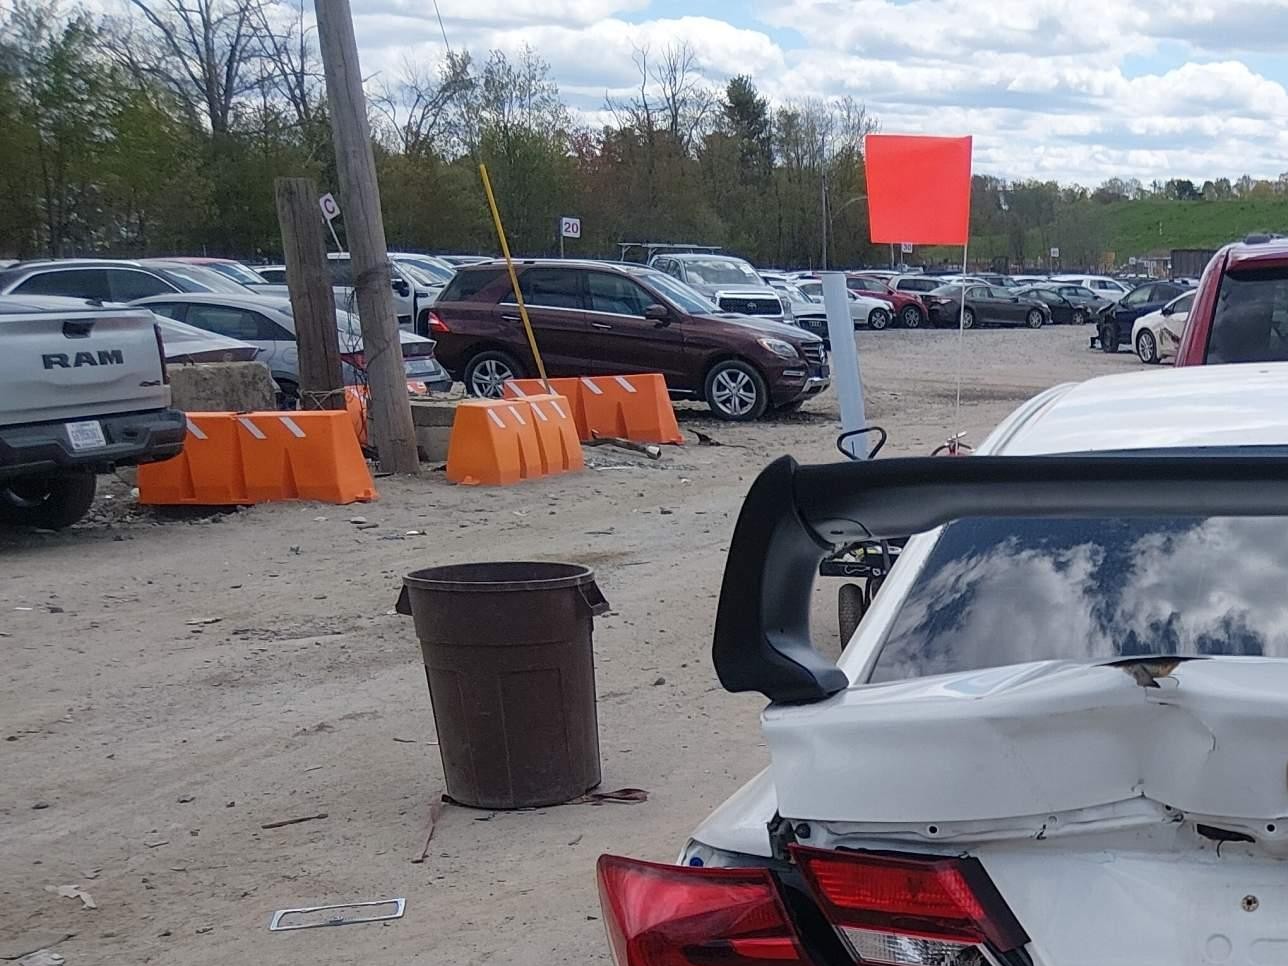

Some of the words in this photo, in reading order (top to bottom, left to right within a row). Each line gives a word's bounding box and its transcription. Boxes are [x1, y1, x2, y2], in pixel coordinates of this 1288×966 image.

[323, 198, 336, 215] C
[564, 222, 579, 234] 20
[42, 350, 124, 370] RAM
